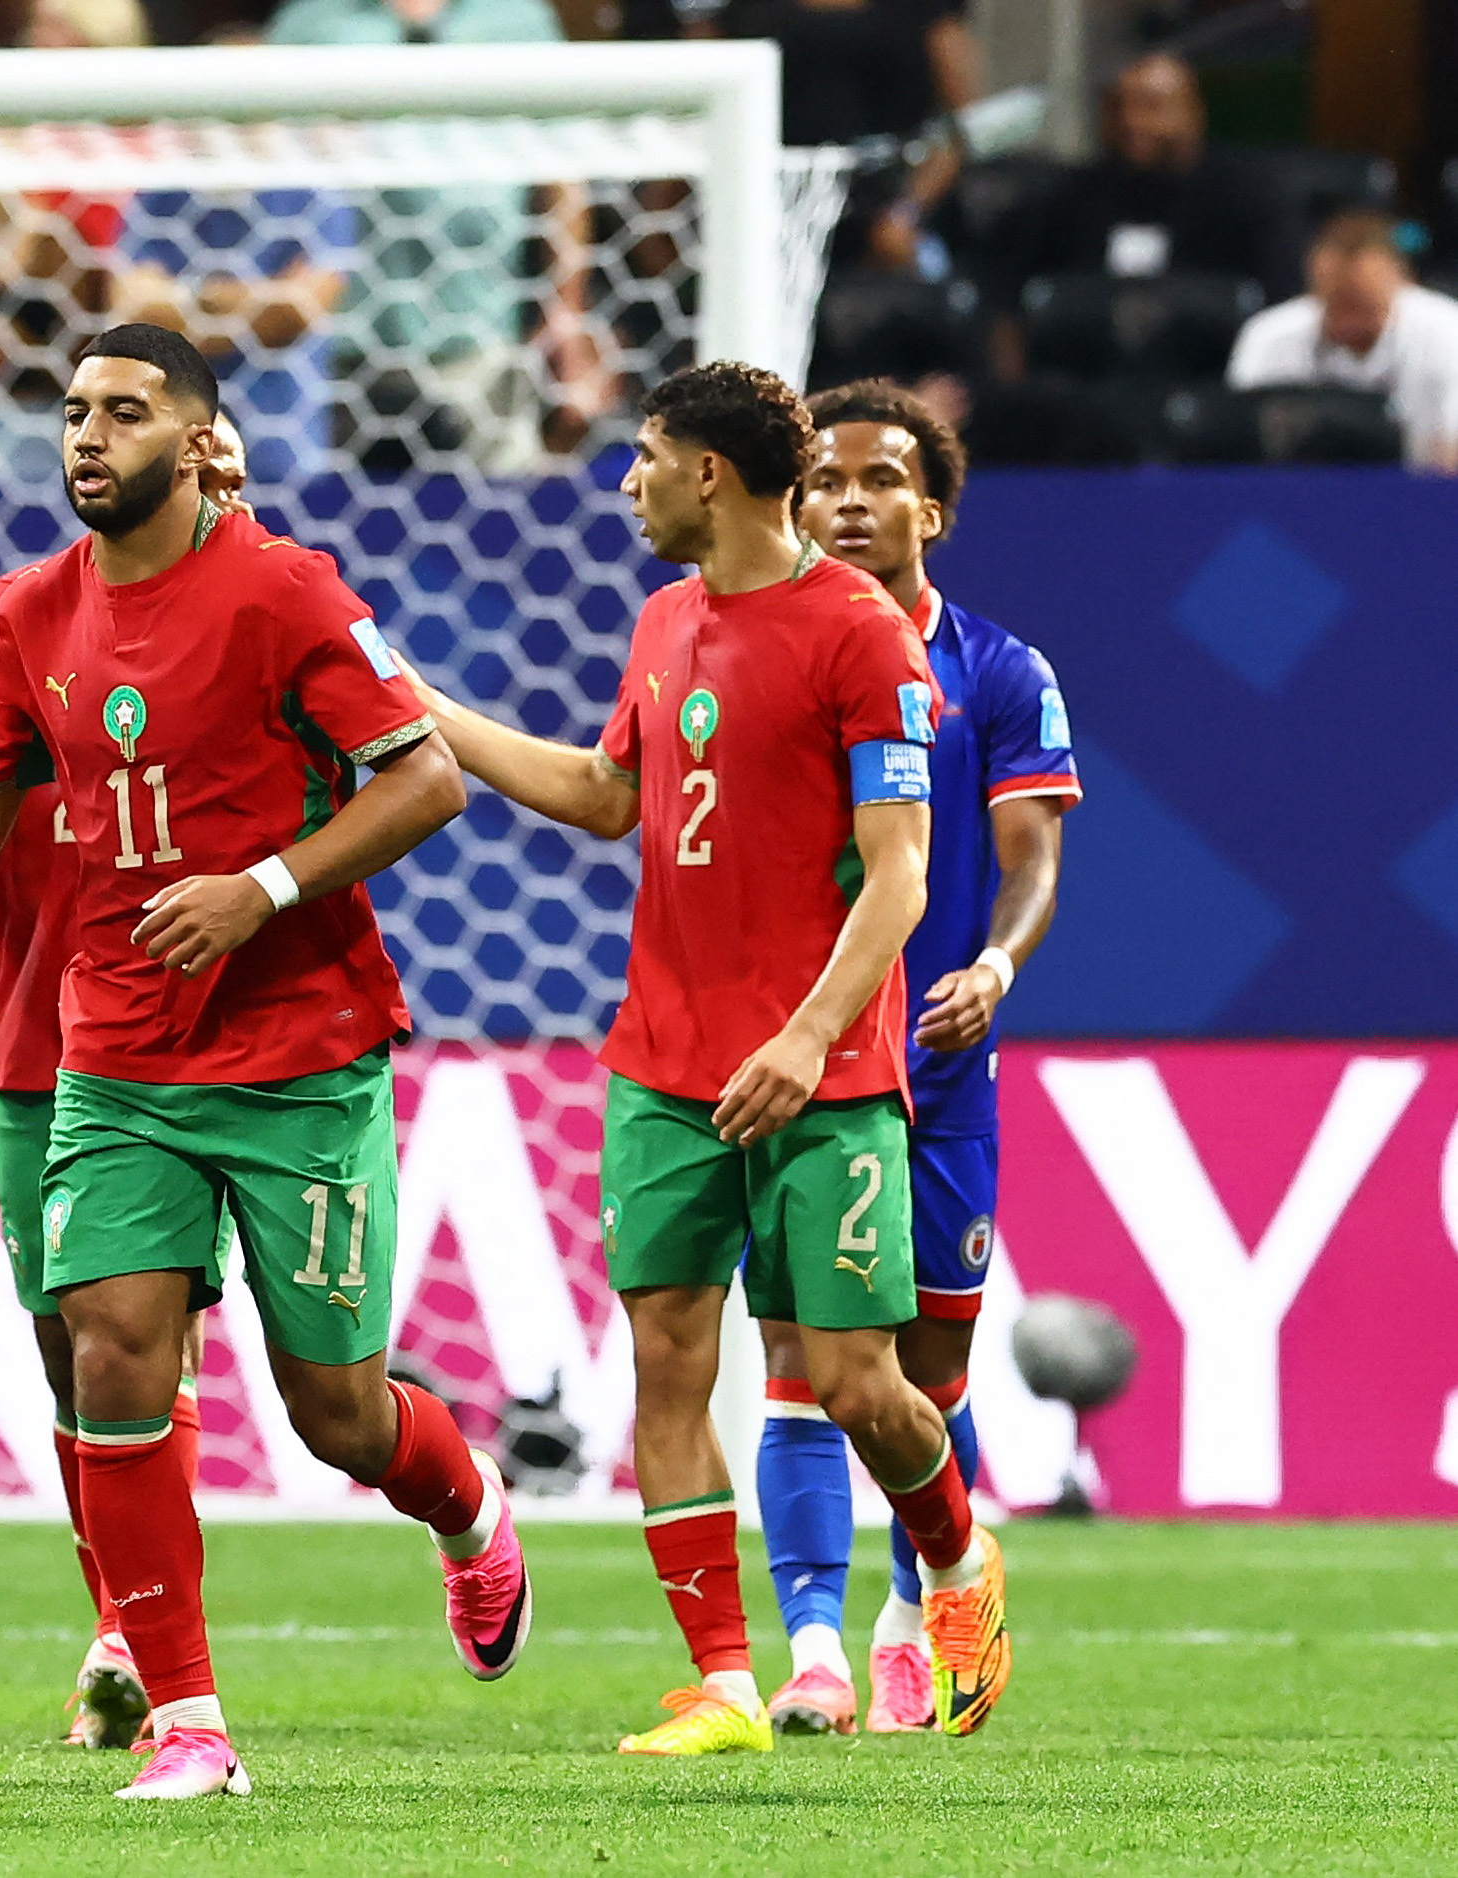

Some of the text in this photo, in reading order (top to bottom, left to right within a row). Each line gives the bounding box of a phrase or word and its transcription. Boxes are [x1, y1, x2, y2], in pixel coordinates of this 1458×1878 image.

[106, 764, 183, 869] 11
[677, 769, 718, 866] 2
[293, 1183, 368, 1287] 11
[837, 1153, 882, 1251] 2
